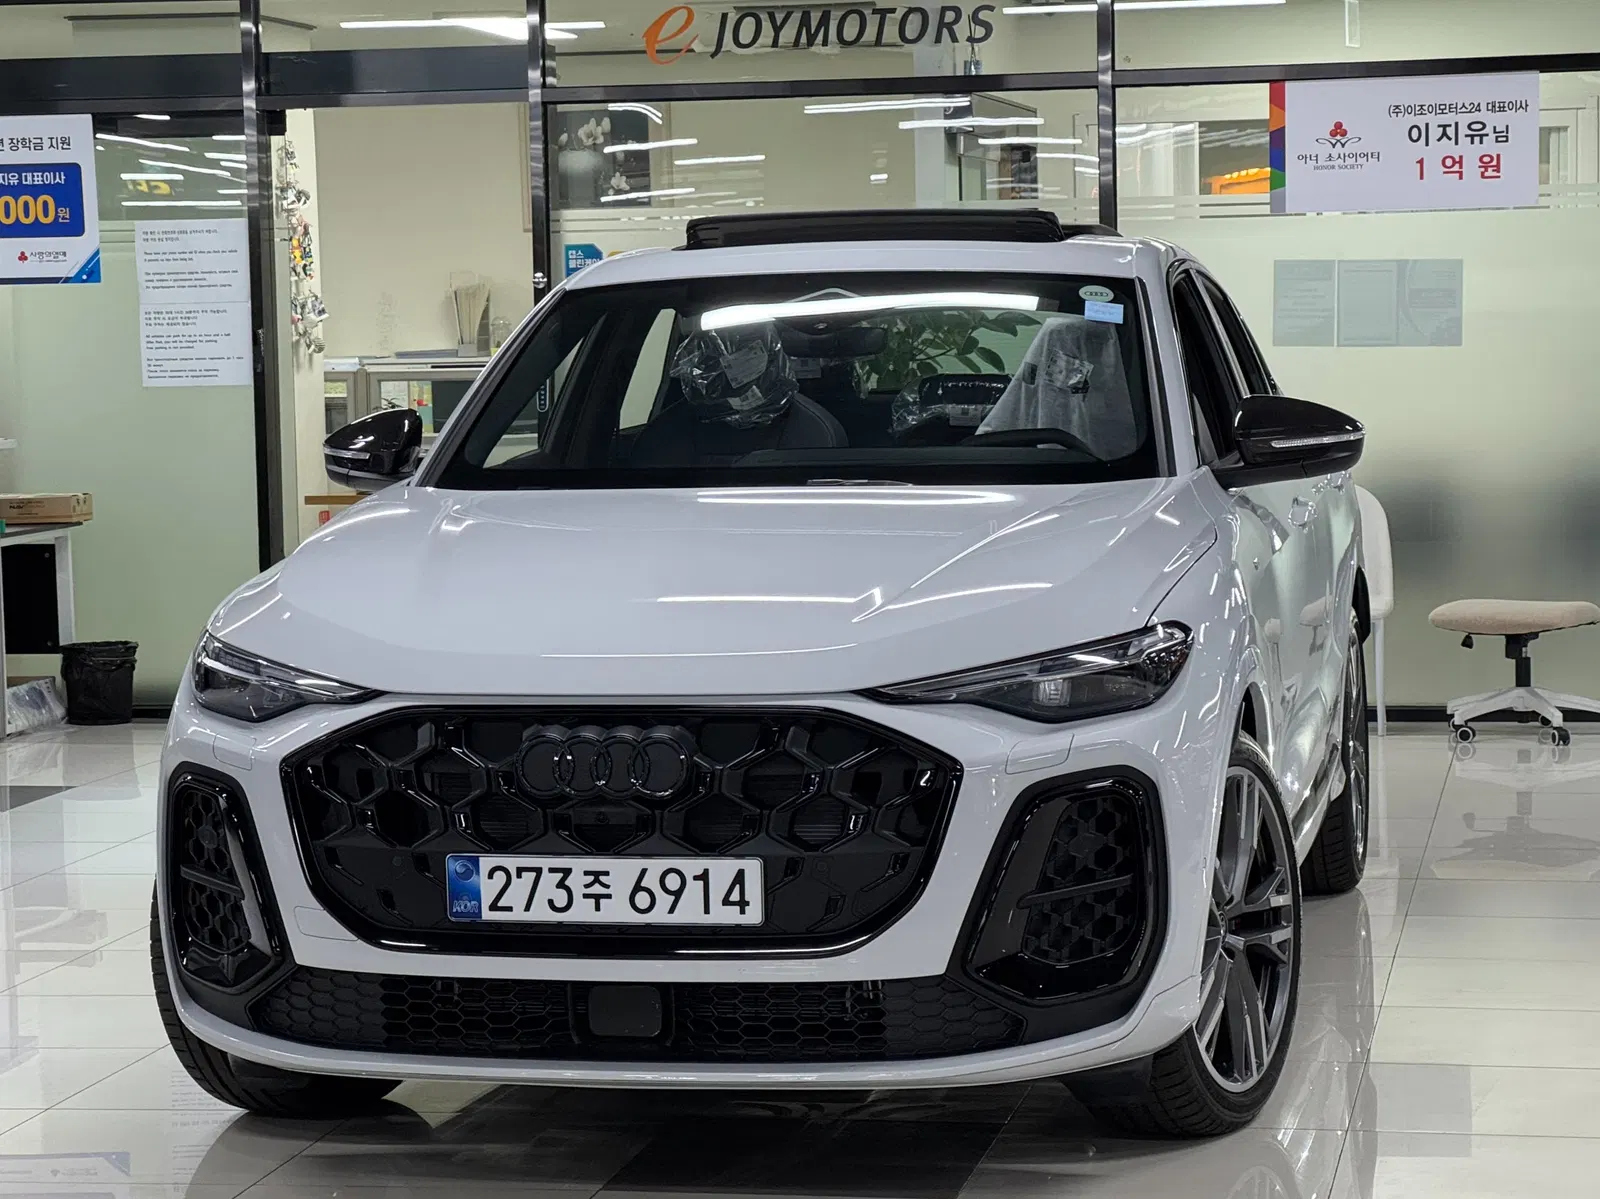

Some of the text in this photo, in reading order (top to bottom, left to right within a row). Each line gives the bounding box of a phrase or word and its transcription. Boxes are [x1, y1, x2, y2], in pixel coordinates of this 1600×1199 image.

[641, 4, 997, 65] e JOYMOTORS
[1388, 99, 1529, 118] (주)이조이모터스24 대표이사
[8, 136, 44, 152] 장학금
[47, 136, 72, 151] 지원
[1297, 151, 1381, 165] 아너 소사이어티
[22, 171, 66, 186] 대표이사
[486, 865, 750, 916] 273주 6914
[452, 900, 479, 913] KOR
